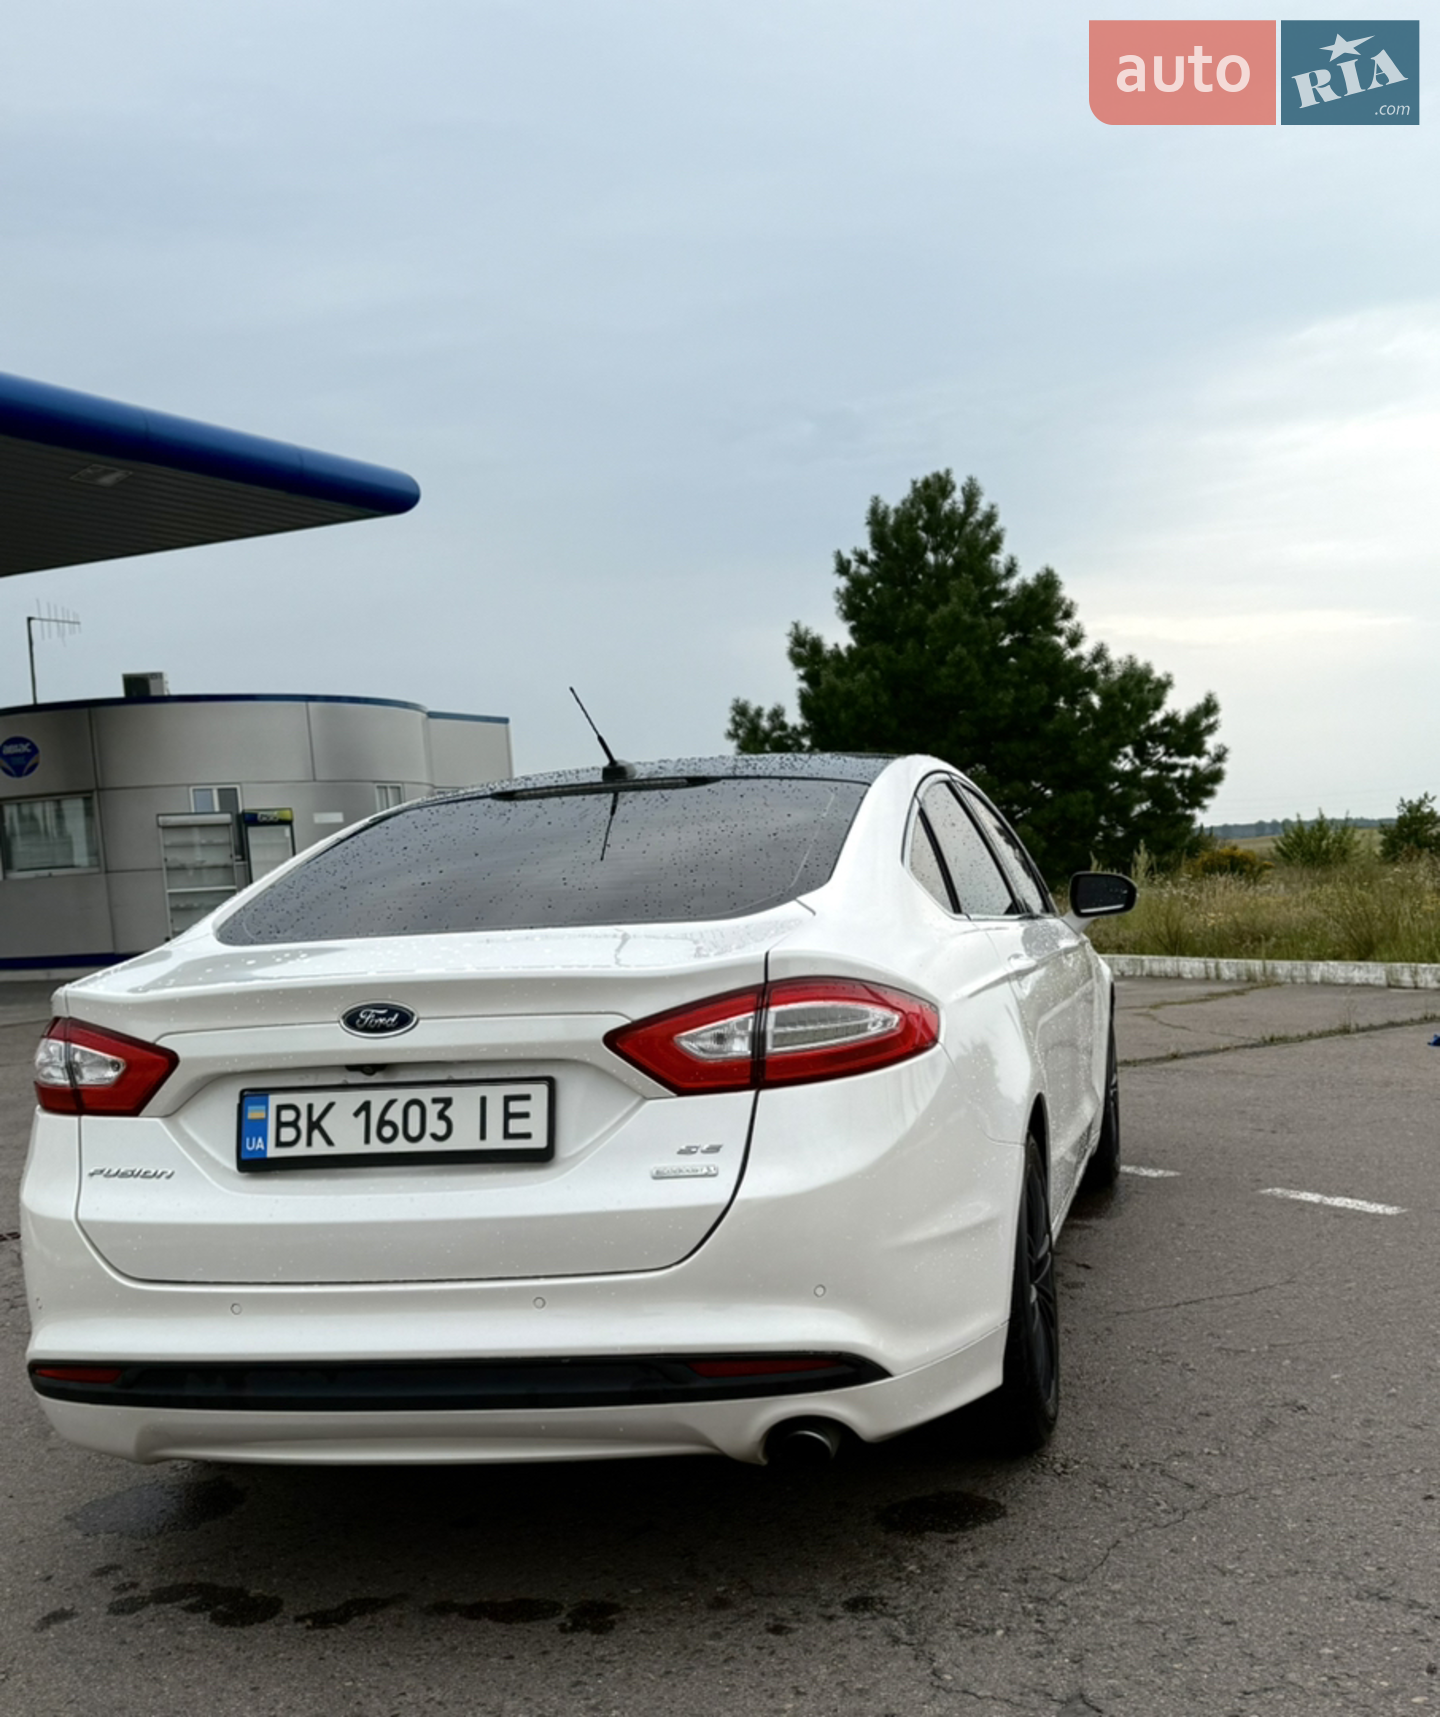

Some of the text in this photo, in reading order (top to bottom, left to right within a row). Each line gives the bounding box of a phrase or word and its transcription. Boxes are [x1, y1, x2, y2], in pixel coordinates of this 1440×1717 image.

[355, 1008, 399, 1029] Ford
[274, 1094, 532, 1148] BK 1603 IE
[246, 1136, 265, 1151] UA
